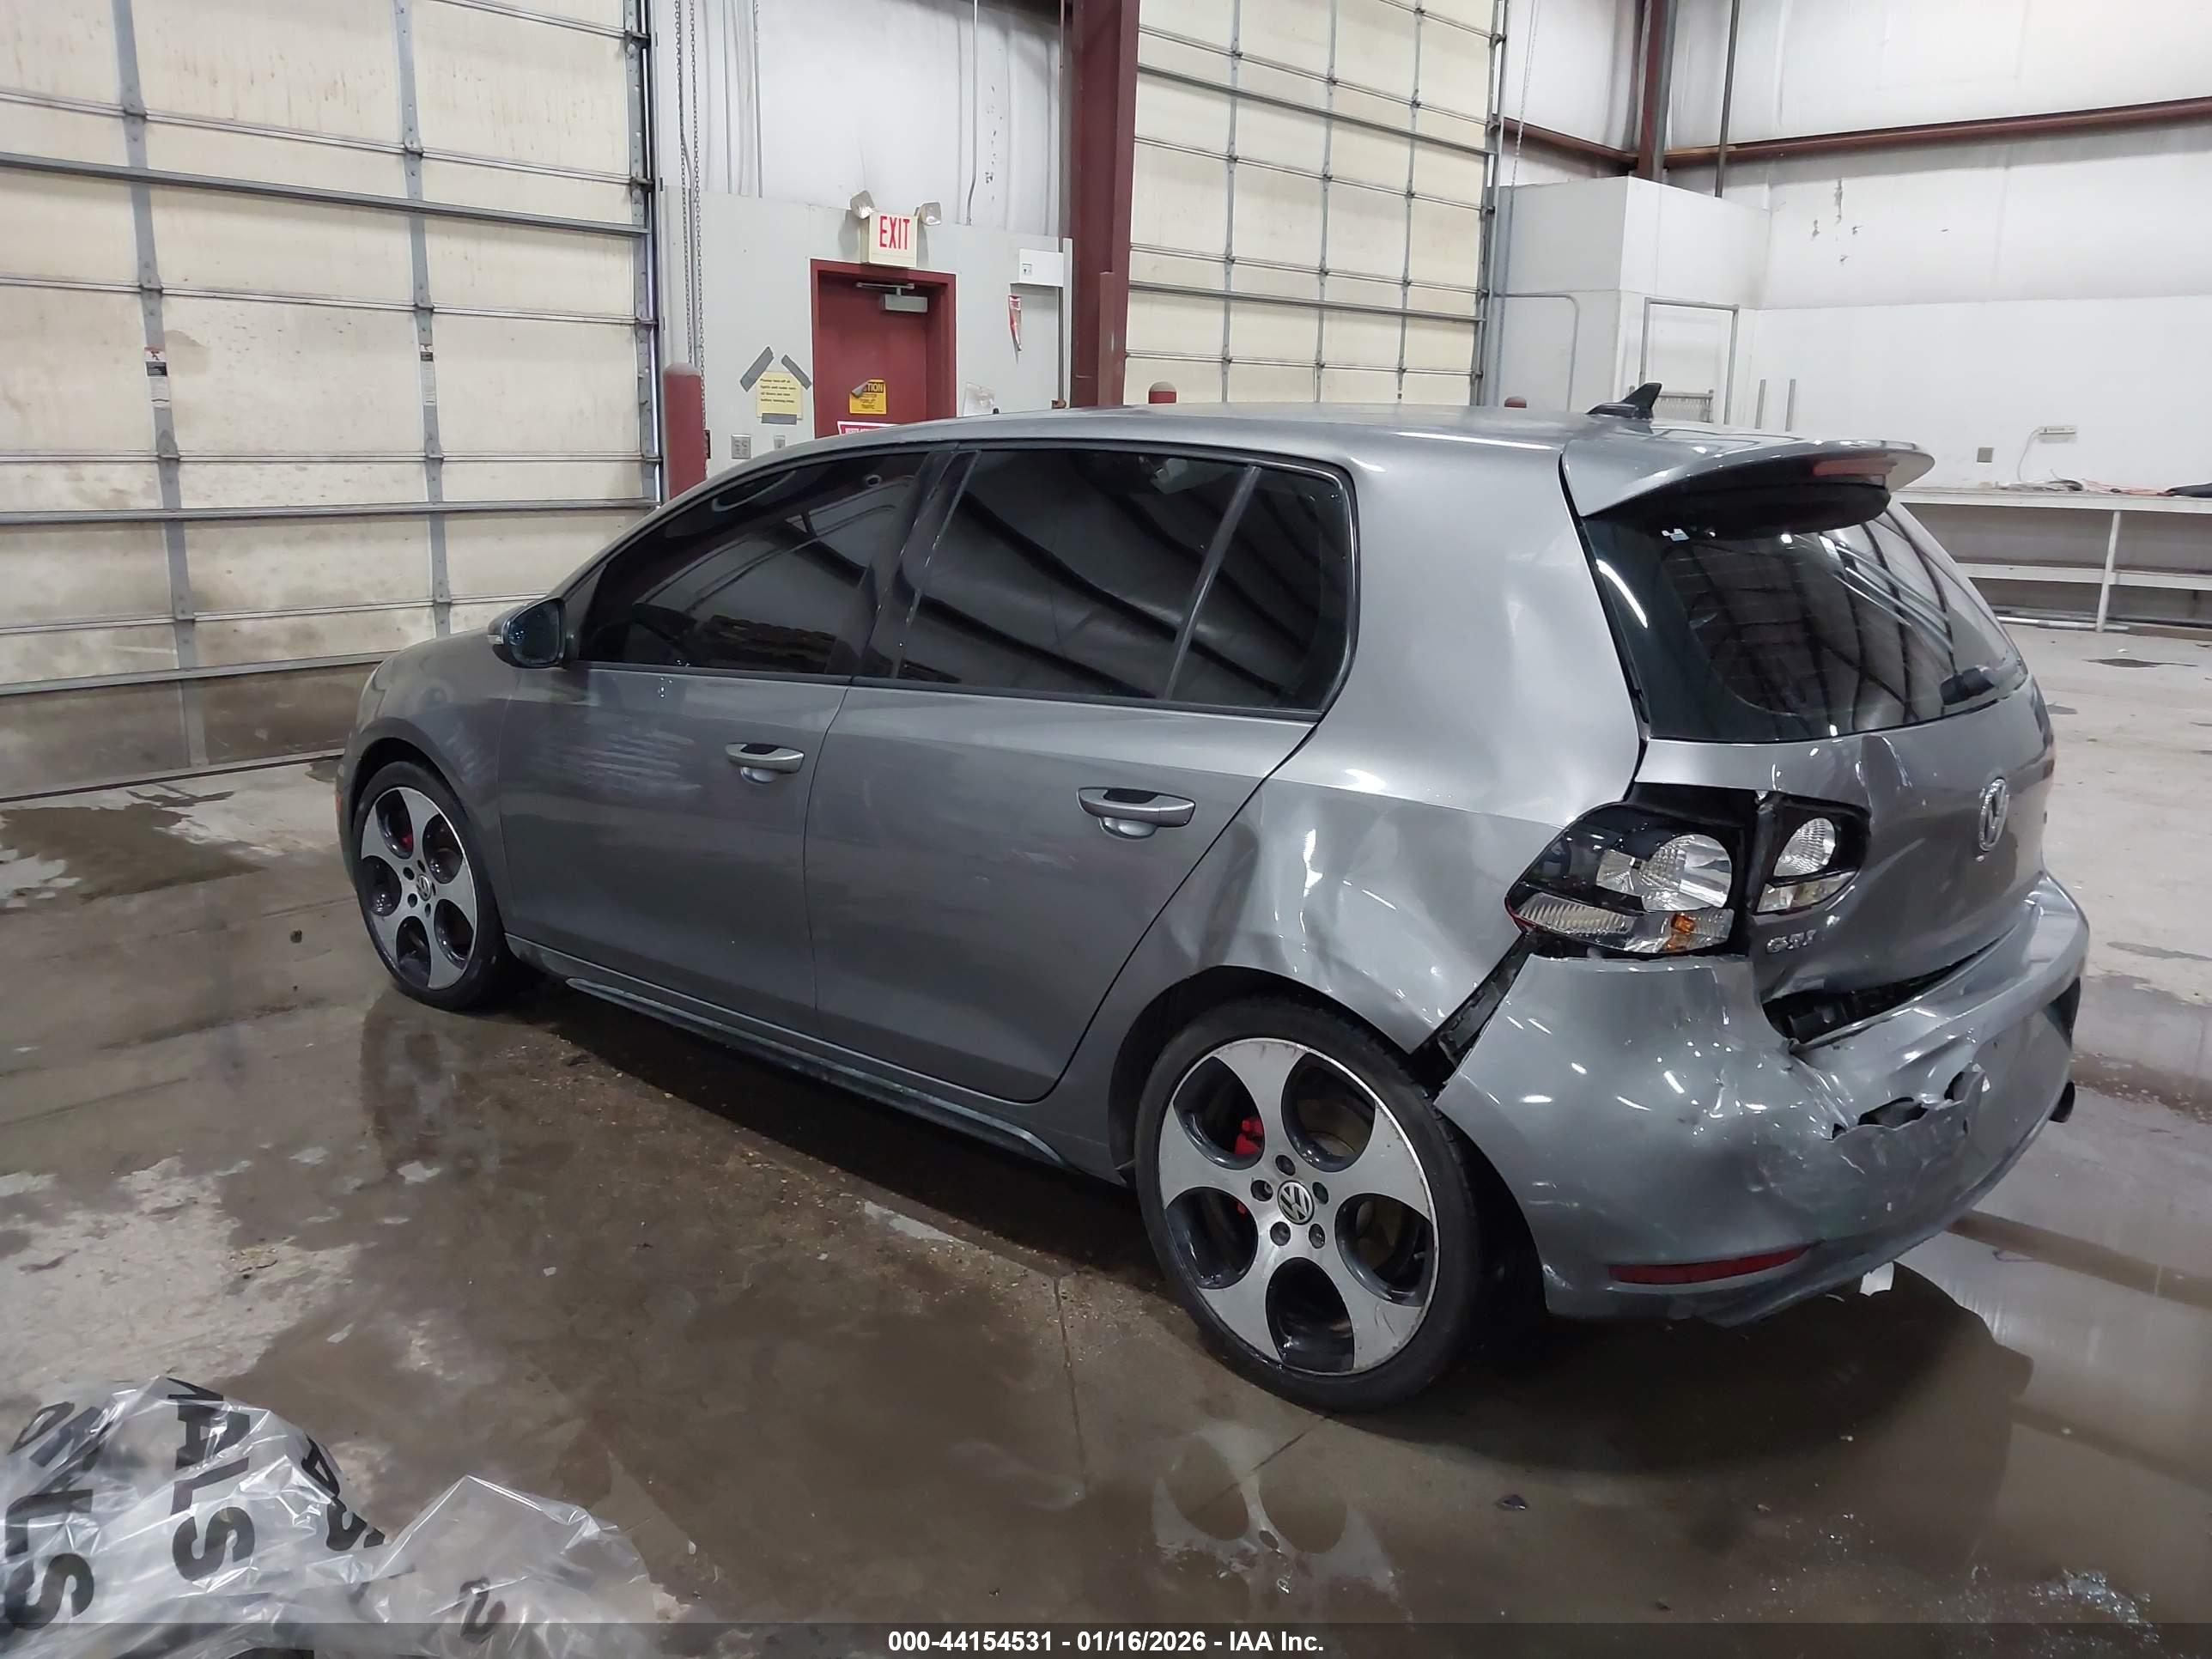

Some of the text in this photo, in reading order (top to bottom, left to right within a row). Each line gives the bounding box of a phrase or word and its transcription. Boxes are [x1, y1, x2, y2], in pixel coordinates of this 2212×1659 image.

[879, 216, 910, 250] EXIT
[864, 383, 884, 392] TION
[1766, 929, 1817, 953] GTI
[1278, 1181, 1314, 1224] VW
